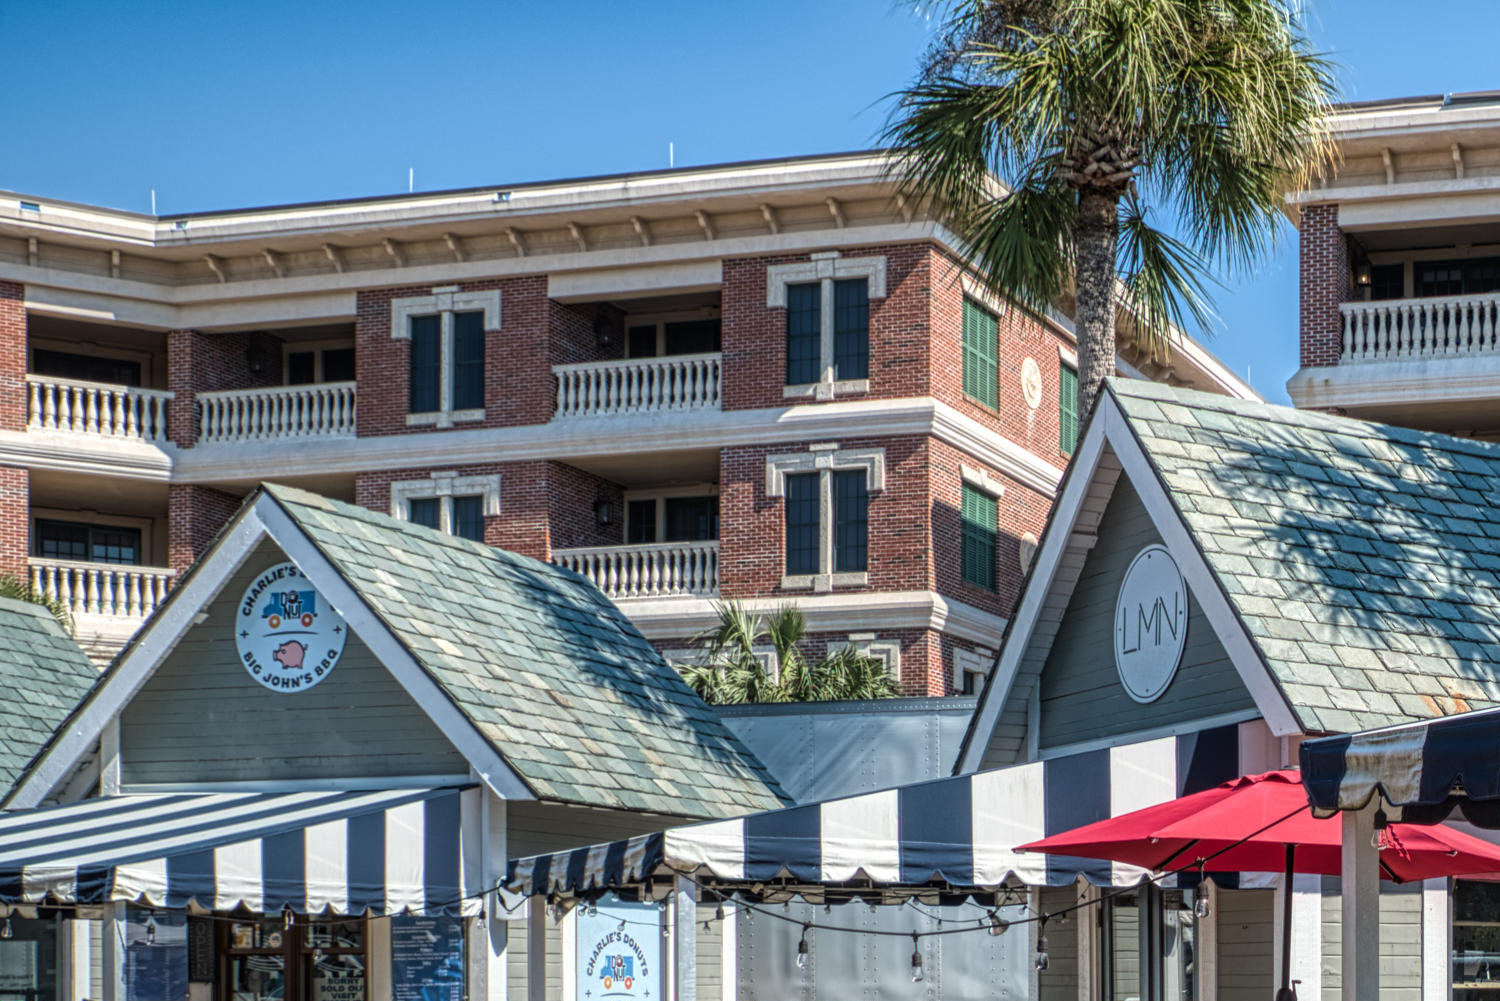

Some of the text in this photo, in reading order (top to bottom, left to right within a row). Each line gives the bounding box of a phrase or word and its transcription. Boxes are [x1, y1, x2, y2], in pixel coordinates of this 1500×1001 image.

[242, 566, 297, 617] CHARLIE'S
[1123, 591, 1178, 655] LMN
[243, 648, 338, 689] BIG JOHN'S BBQ
[587, 931, 649, 977] CHARLIE'S DONUTS
